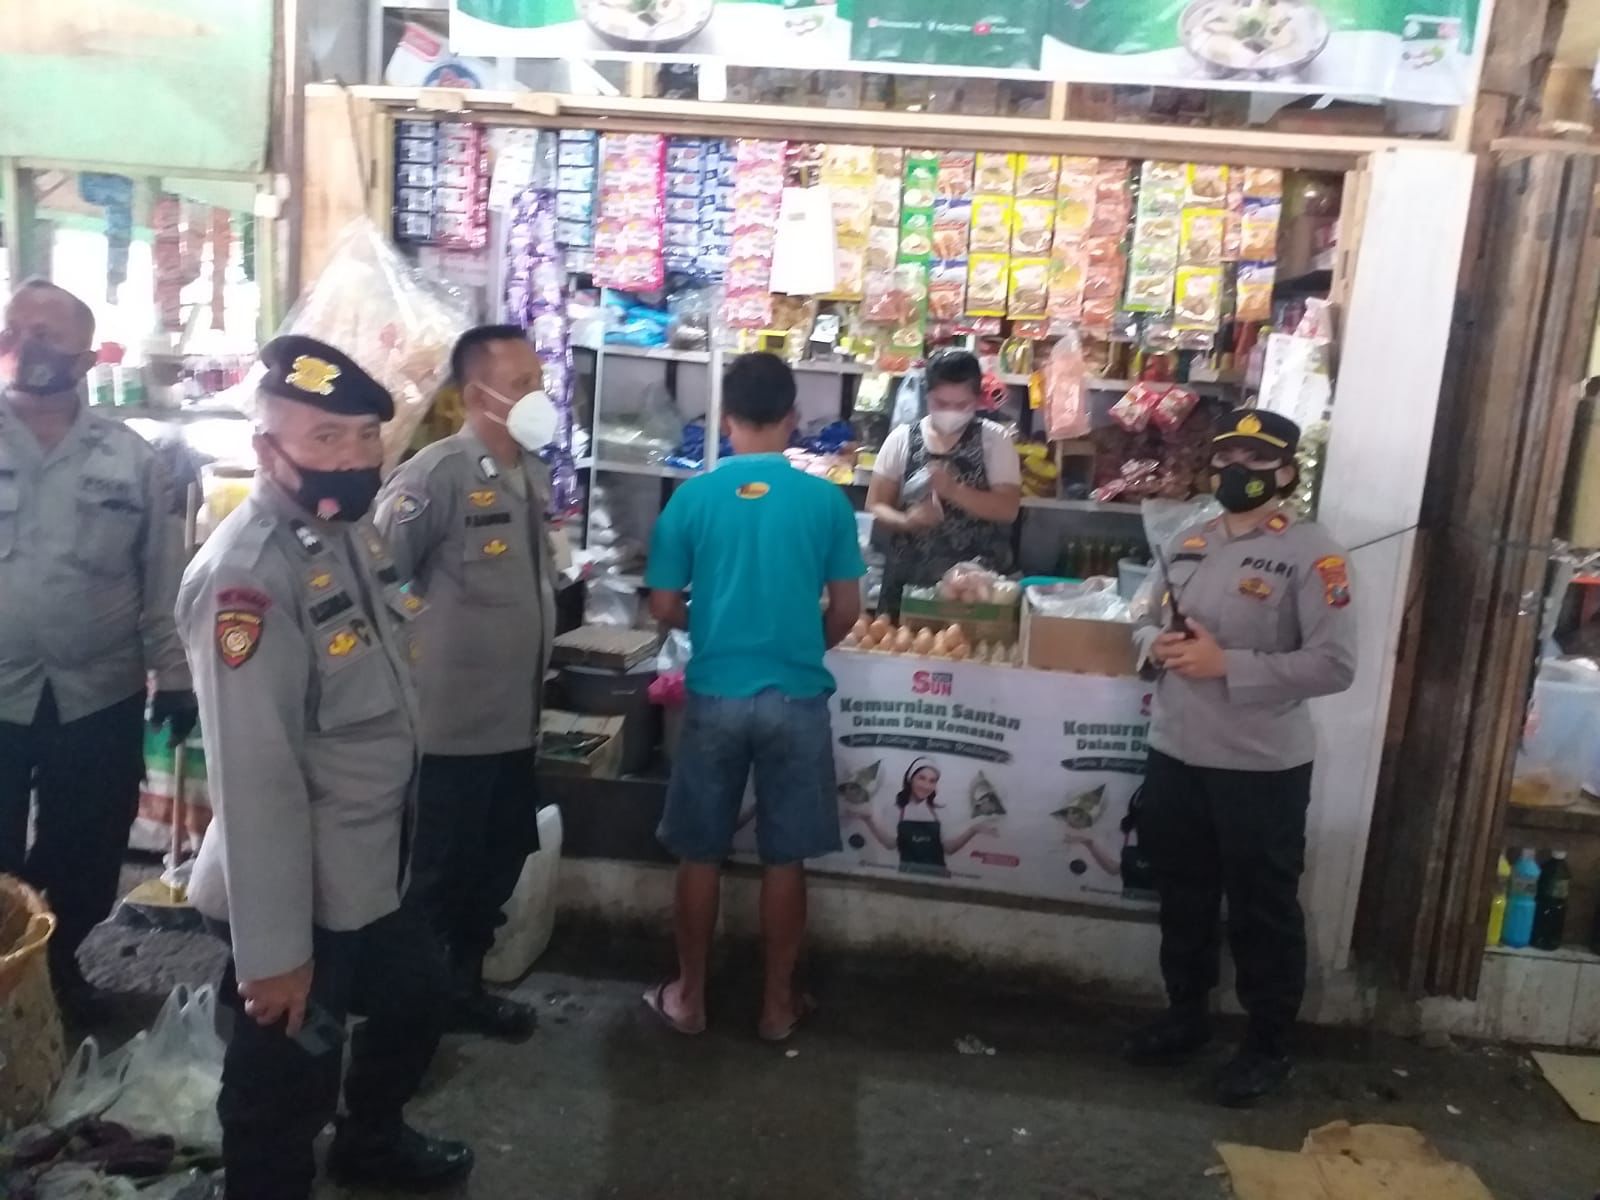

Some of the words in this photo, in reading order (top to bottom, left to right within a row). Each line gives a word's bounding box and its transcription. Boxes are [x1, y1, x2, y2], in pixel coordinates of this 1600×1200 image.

[1240, 556, 1295, 578] POLRI
[840, 699, 947, 716] Kemurnian
[952, 704, 1020, 731] Santan
[853, 716, 900, 728] Dalam
[903, 717, 933, 730] Dua
[936, 719, 1005, 741] Kemasan
[1063, 721, 1151, 736] Kemurni
[1076, 739, 1127, 751] Dalam
[1130, 740, 1151, 753] Du
